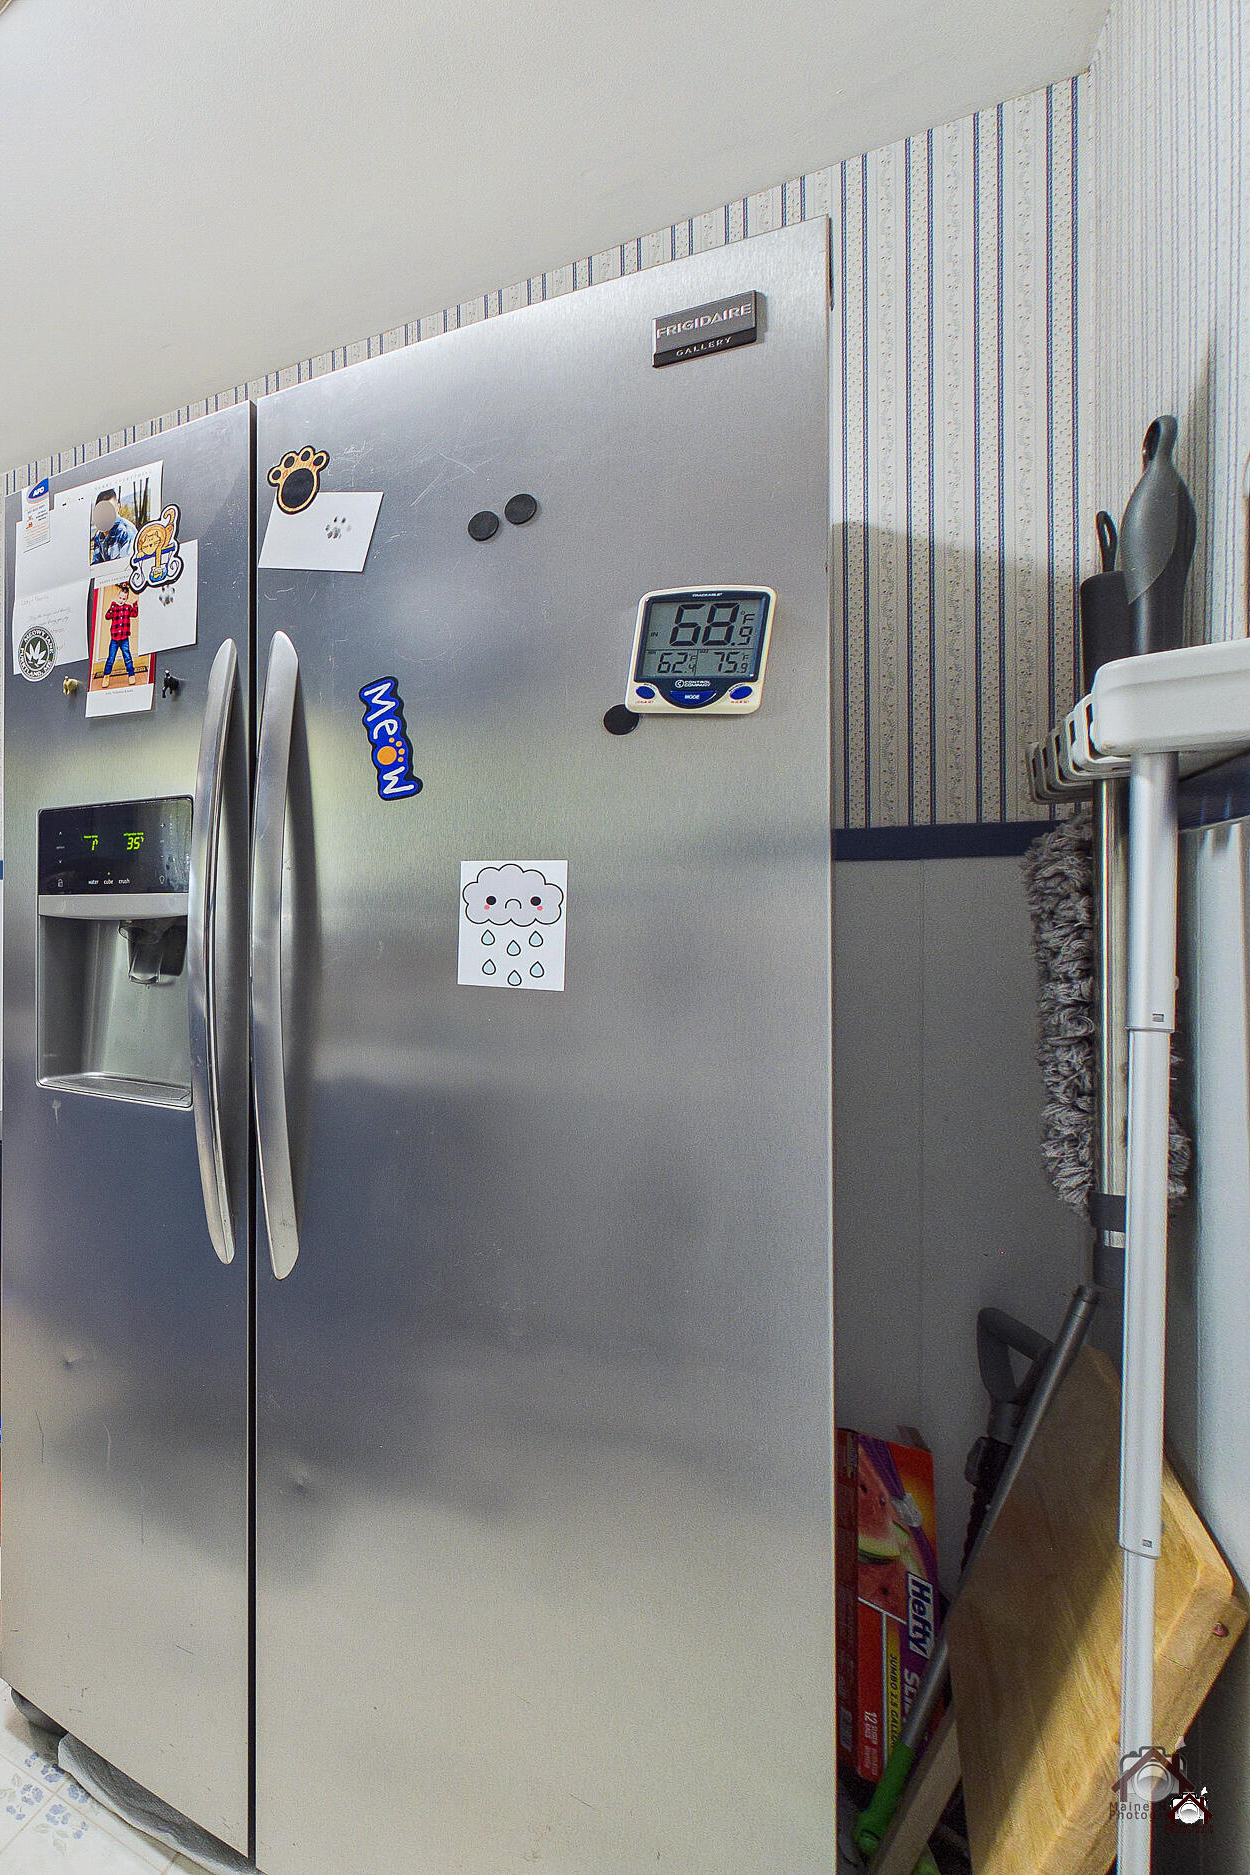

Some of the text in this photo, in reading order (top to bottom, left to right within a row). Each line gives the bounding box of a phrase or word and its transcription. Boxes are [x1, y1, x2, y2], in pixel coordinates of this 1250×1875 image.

[656, 303, 752, 339] FRIGIDAIRE
[676, 336, 732, 357] GALLERY
[910, 1578, 933, 1658] Hefty
[864, 1711, 877, 1724] 12
